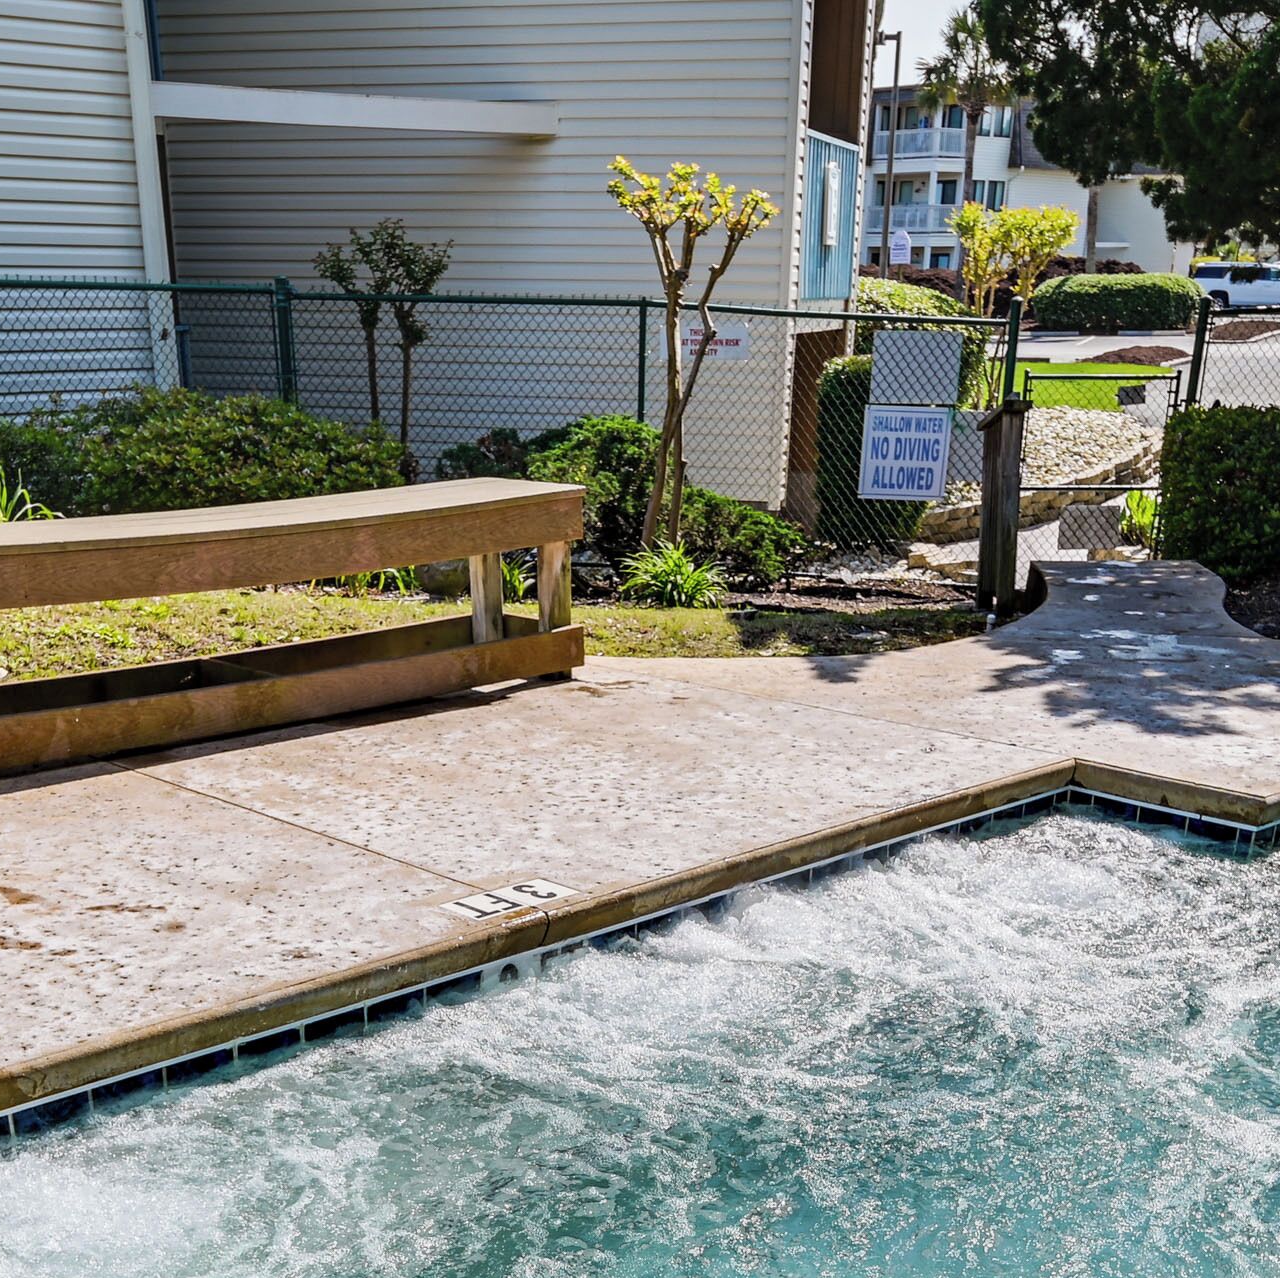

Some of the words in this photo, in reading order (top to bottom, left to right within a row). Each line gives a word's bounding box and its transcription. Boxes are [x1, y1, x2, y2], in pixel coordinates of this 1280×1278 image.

[872, 415, 913, 433] SHALLOW
[915, 417, 944, 434] WATER
[871, 436, 889, 460] NO
[894, 437, 940, 462] DIVING
[871, 465, 934, 490] ALLOWED
[512, 884, 556, 899] 3
[453, 893, 522, 918] FT
